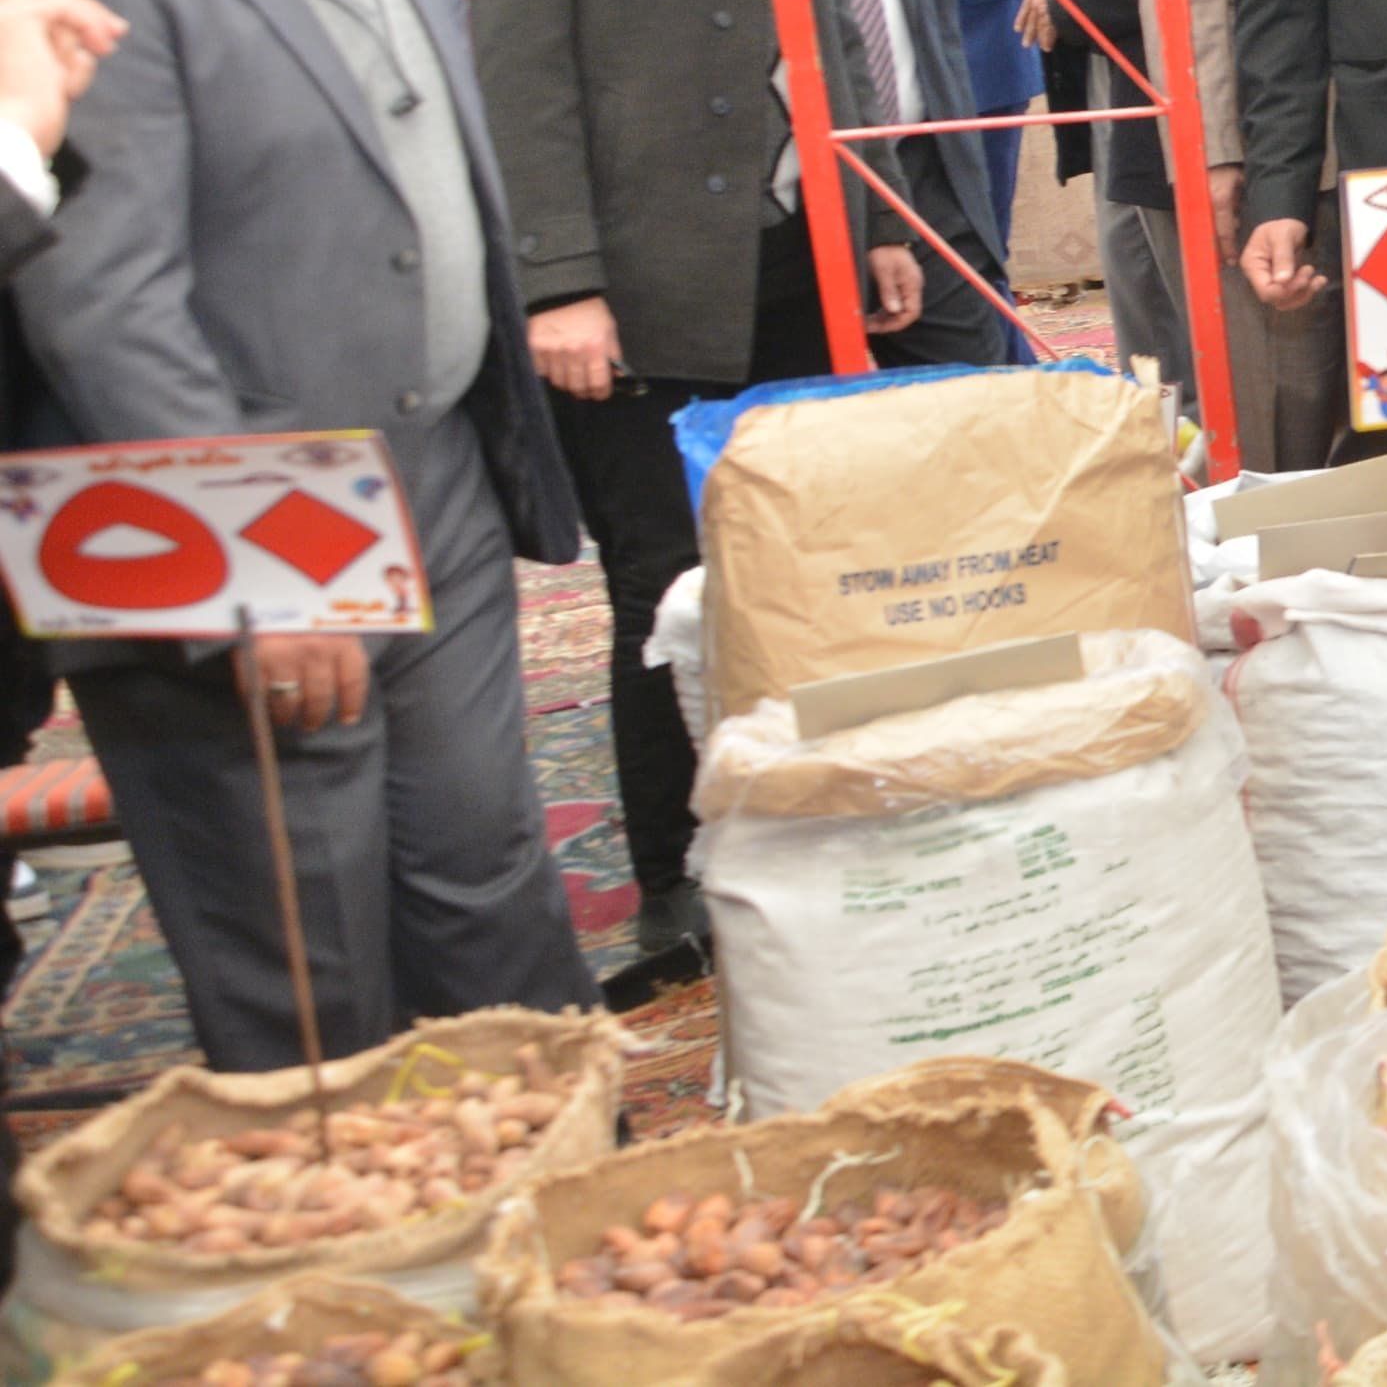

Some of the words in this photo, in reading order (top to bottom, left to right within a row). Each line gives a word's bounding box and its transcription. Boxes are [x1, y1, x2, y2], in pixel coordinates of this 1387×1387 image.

[38, 479, 384, 610] ٥٠
[838, 566, 895, 597] STOW
[900, 560, 951, 590] AWAY
[957, 552, 1012, 579] FROM
[1015, 541, 1060, 569] HEAT
[884, 598, 926, 625] USE
[928, 592, 960, 619] NO
[963, 583, 1027, 613] HOOKS
